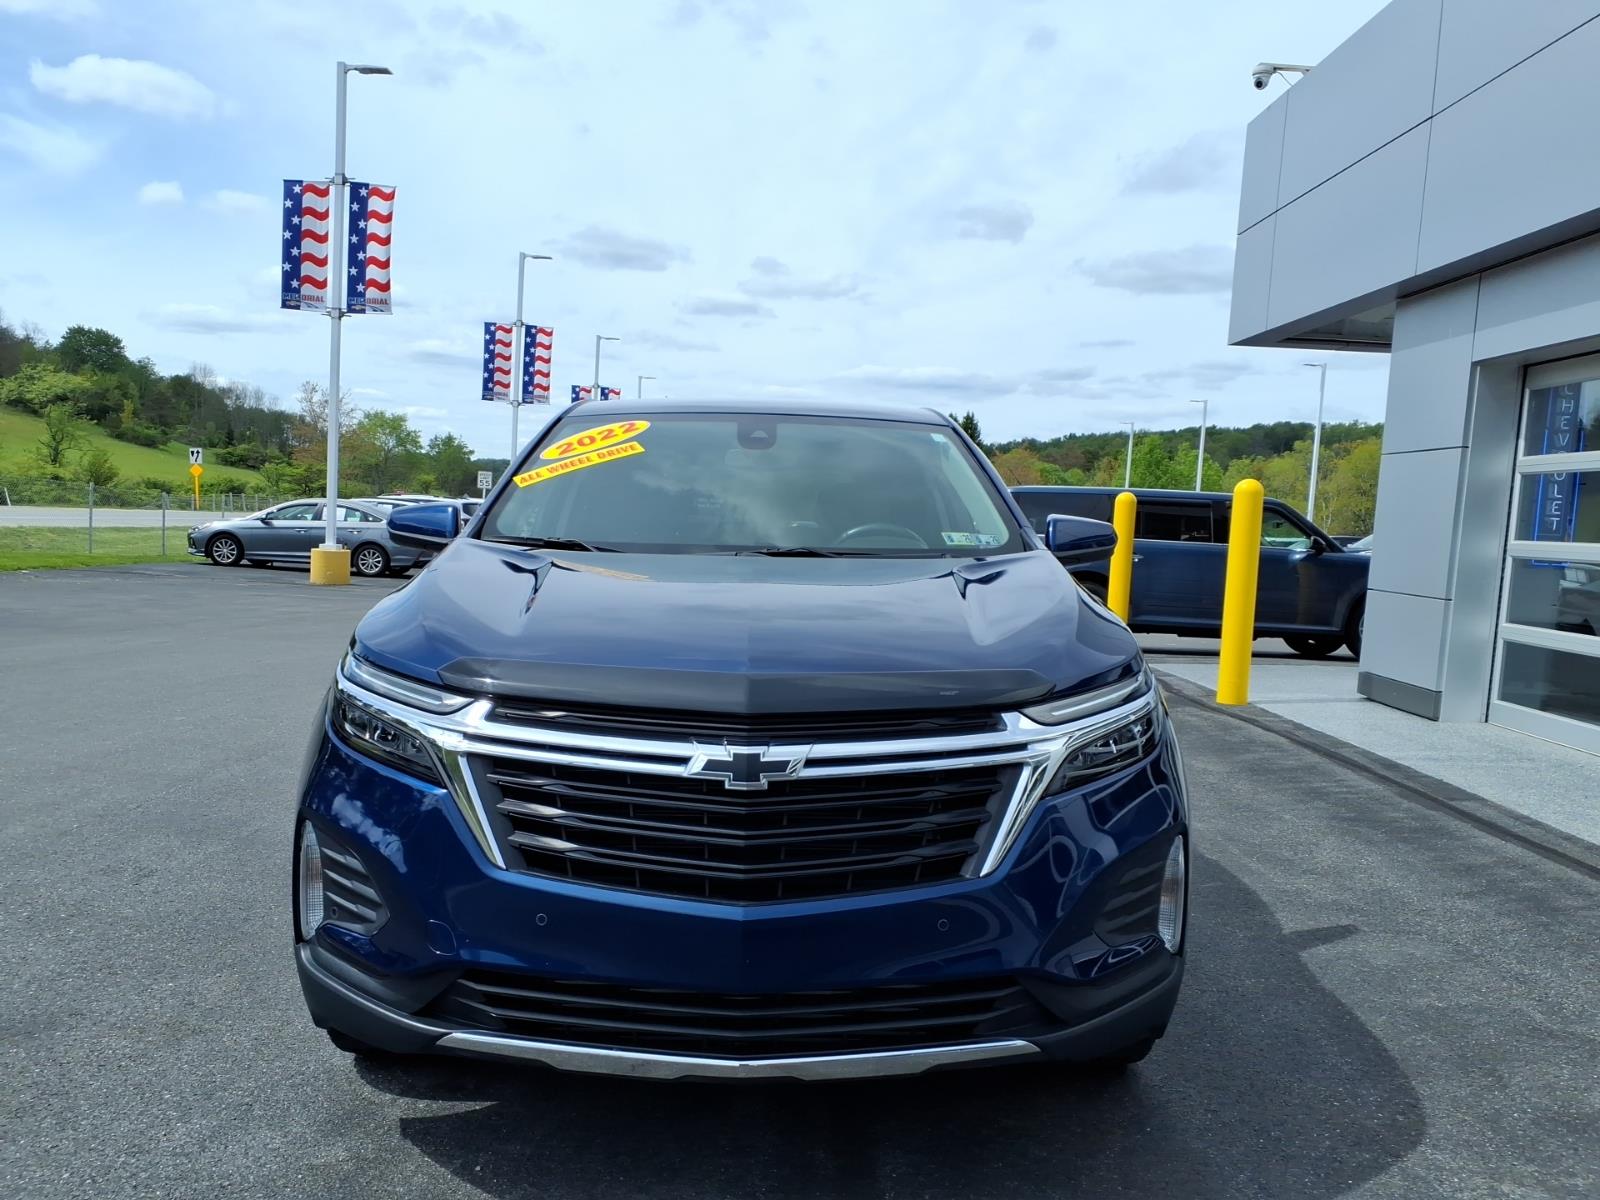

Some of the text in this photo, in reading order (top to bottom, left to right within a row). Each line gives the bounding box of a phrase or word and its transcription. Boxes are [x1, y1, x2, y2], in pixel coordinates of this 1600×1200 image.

[556, 422, 640, 456] 2022
[1550, 385, 1574, 531] CHEVOLET
[519, 444, 639, 484] ALL WHEEL DRIVE
